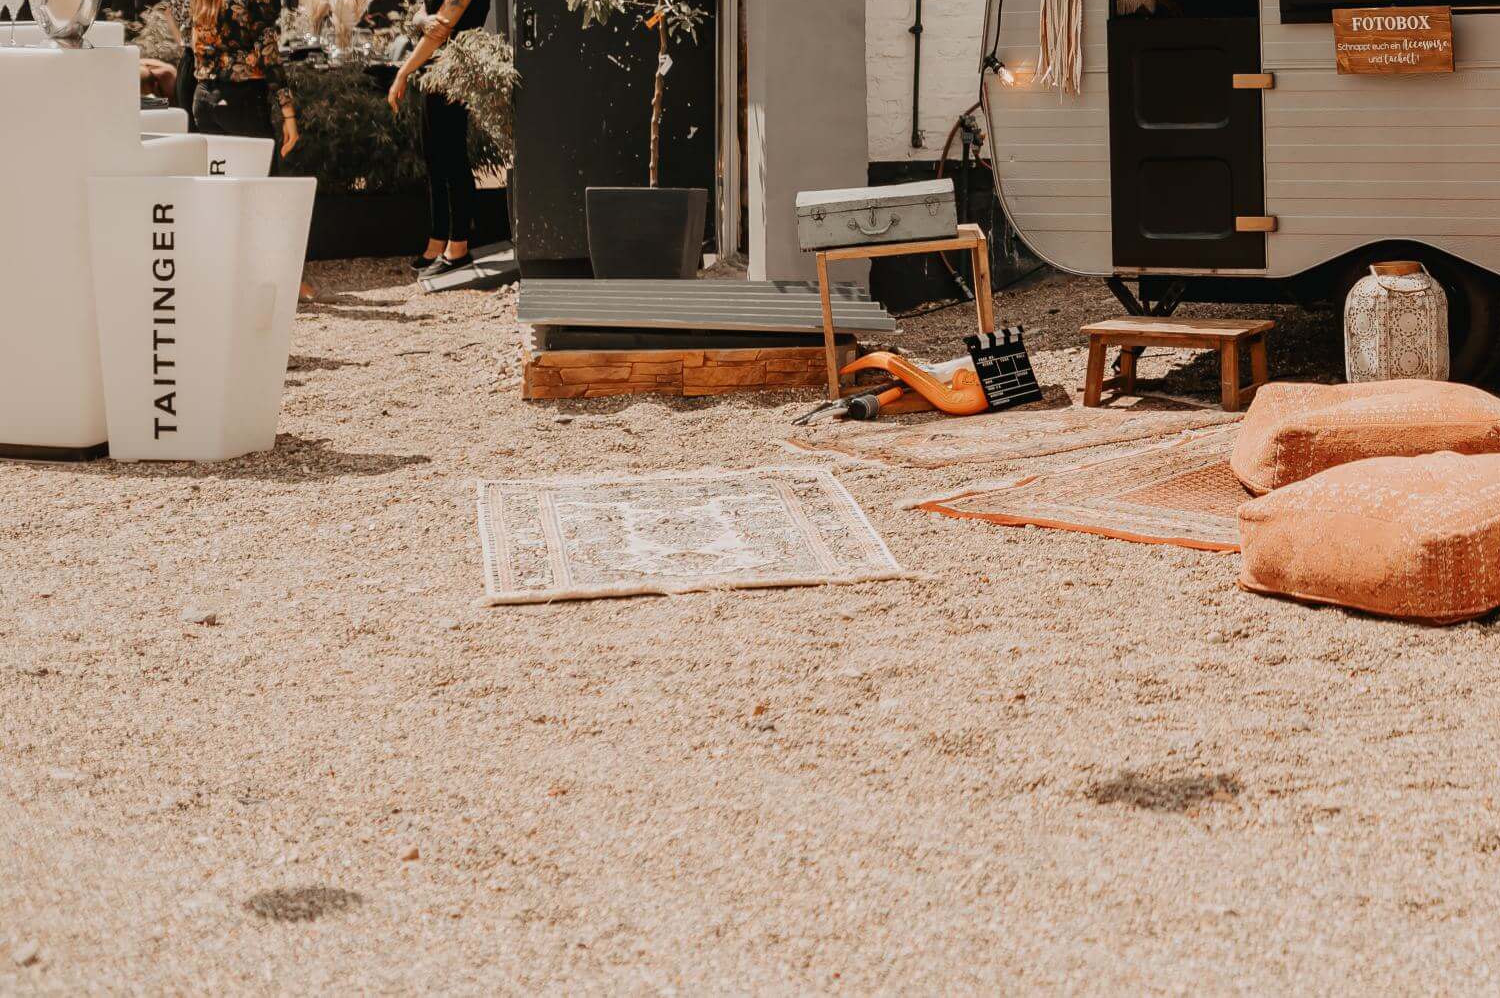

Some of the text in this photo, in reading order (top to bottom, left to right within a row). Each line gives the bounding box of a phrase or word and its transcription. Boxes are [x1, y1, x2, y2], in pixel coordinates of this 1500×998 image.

[1351, 15, 1431, 31] FOTOBOX
[1337, 43, 1370, 52] Schnappt
[1372, 42, 1390, 51] euch
[1390, 42, 1400, 50] ein
[1368, 55, 1383, 63] und
[152, 203, 177, 440] TAITTINGER
